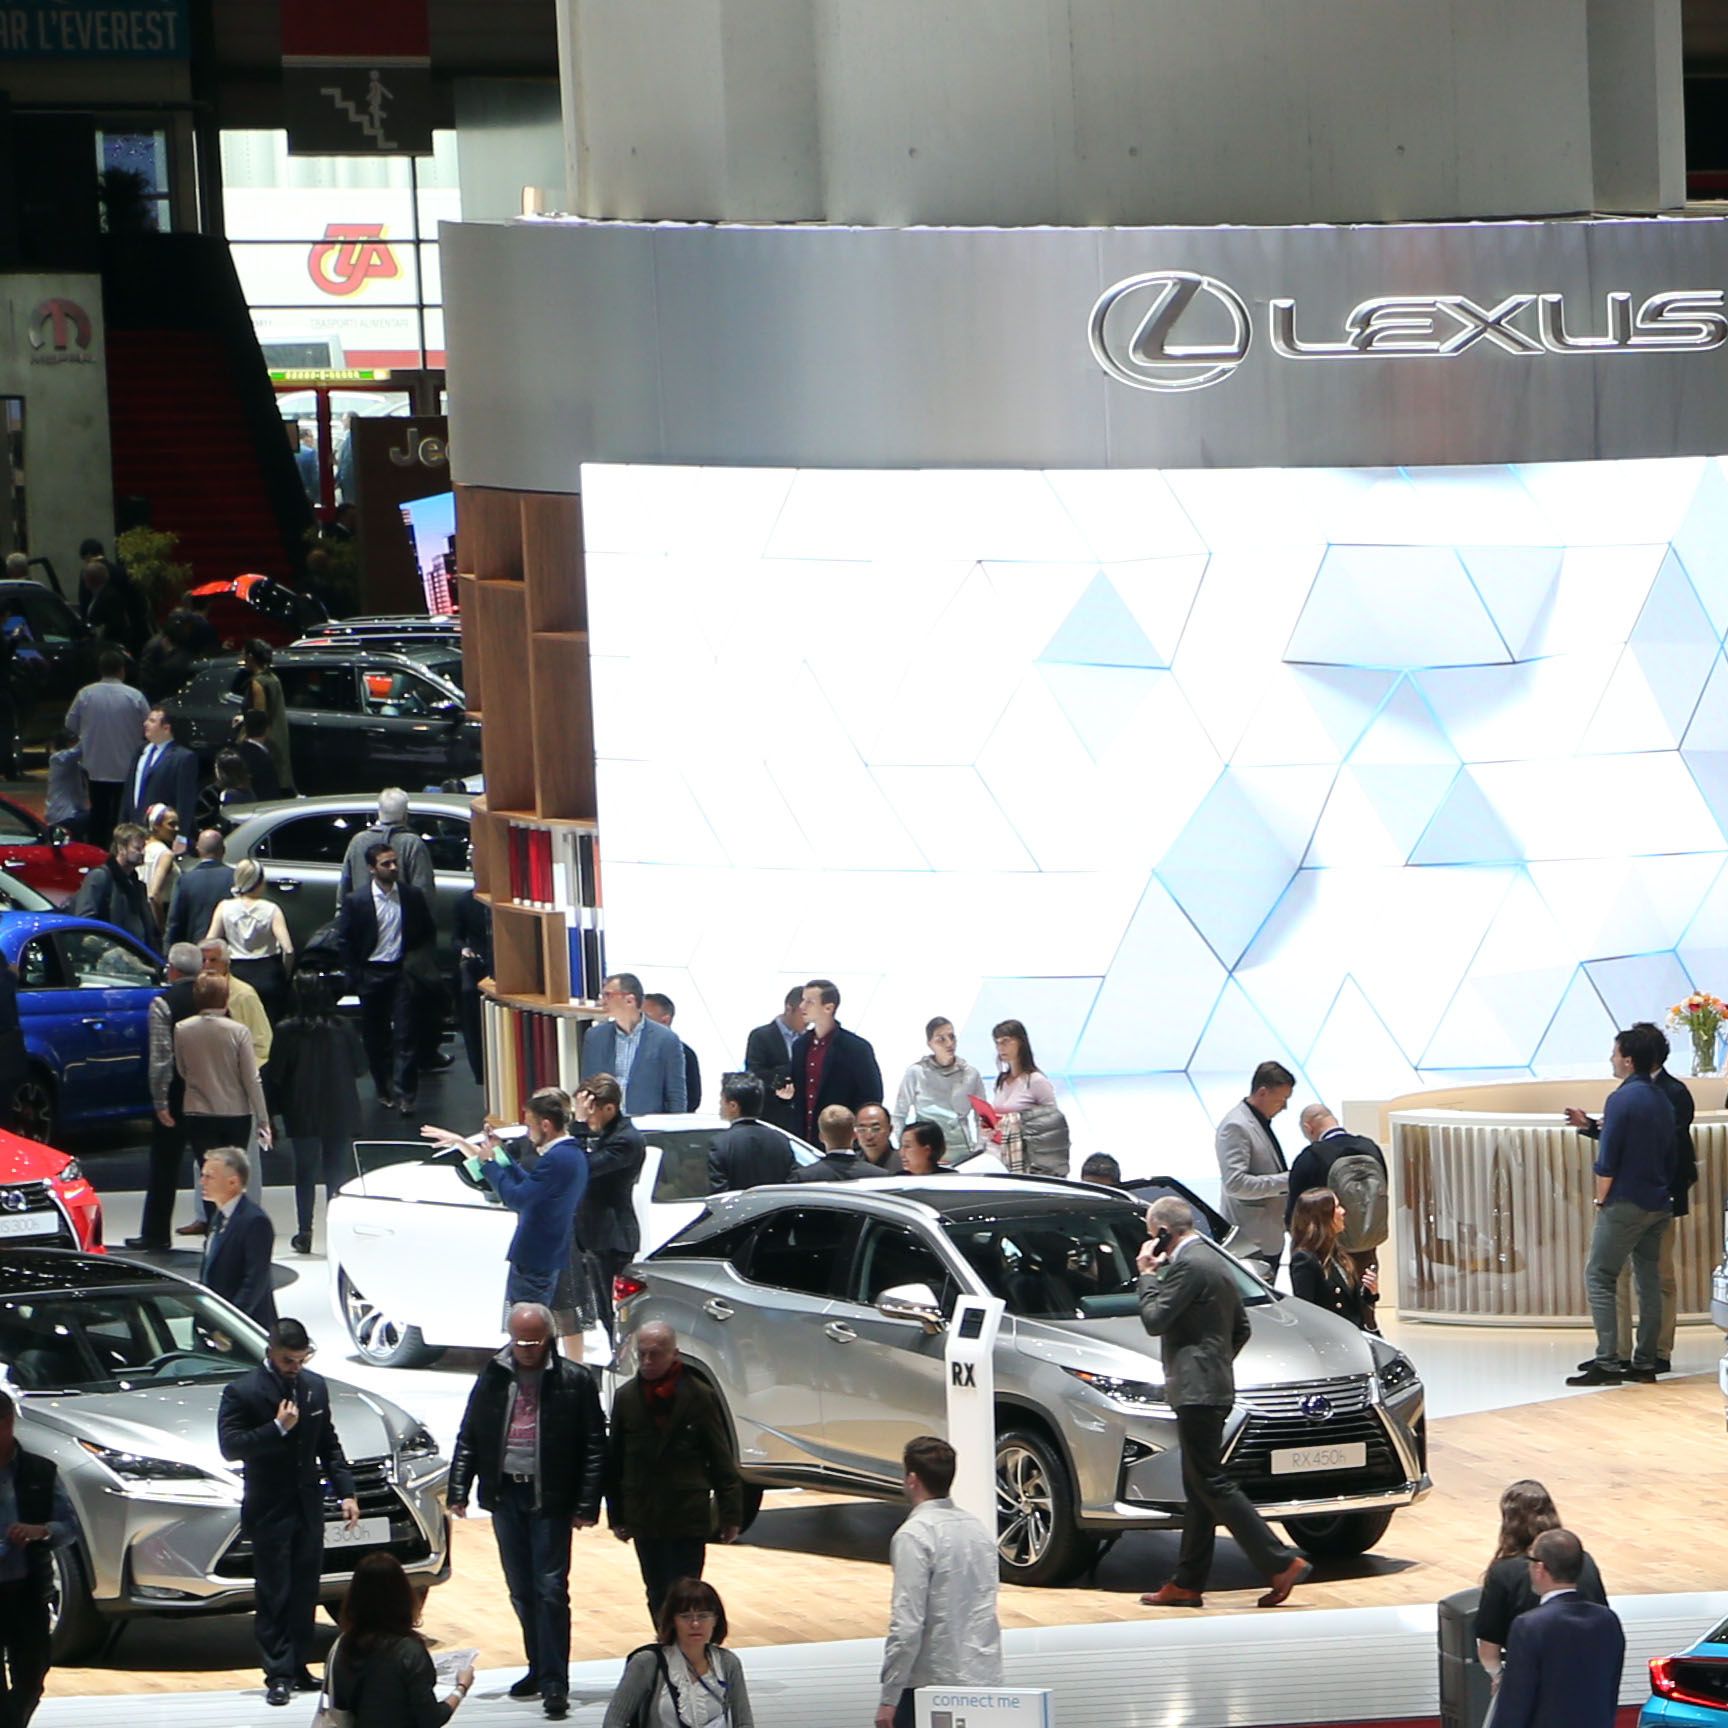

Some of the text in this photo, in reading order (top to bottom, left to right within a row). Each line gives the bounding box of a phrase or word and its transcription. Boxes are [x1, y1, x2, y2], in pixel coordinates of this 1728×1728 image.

[37, 9, 178, 50] L'EVEREST
[310, 318, 409, 329] TRASPORTI ALIMENTARI
[13, 1220, 40, 1232] 300h
[951, 1361, 976, 1388] RX
[1292, 1449, 1345, 1469] RX 450h
[932, 1695, 1021, 1708] connect me
